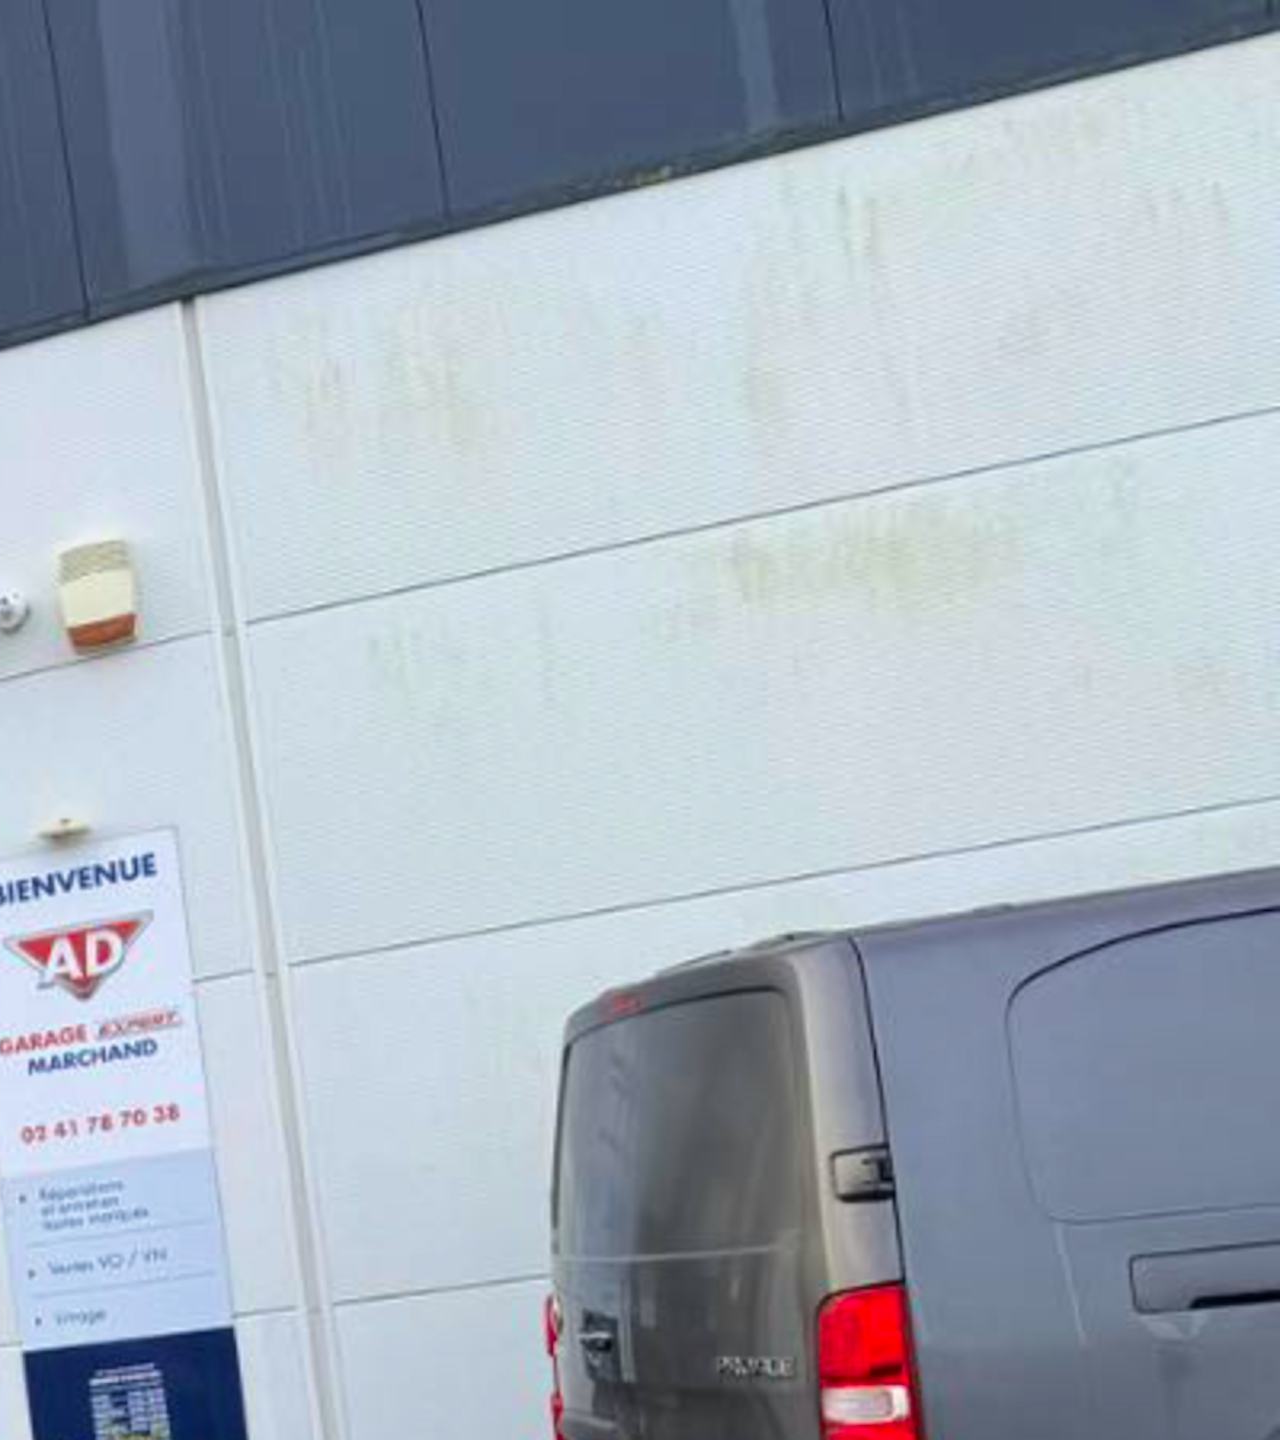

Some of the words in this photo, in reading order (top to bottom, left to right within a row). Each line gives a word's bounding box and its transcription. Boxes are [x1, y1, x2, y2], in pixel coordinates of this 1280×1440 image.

[40, 928, 124, 982] AD
[27, 1038, 158, 1076] MARCHAND
[20, 1125, 48, 1144] 02
[54, 1119, 78, 1138] 41
[86, 1113, 113, 1134] 78
[119, 1108, 147, 1128] 70
[152, 1102, 180, 1123] 38
